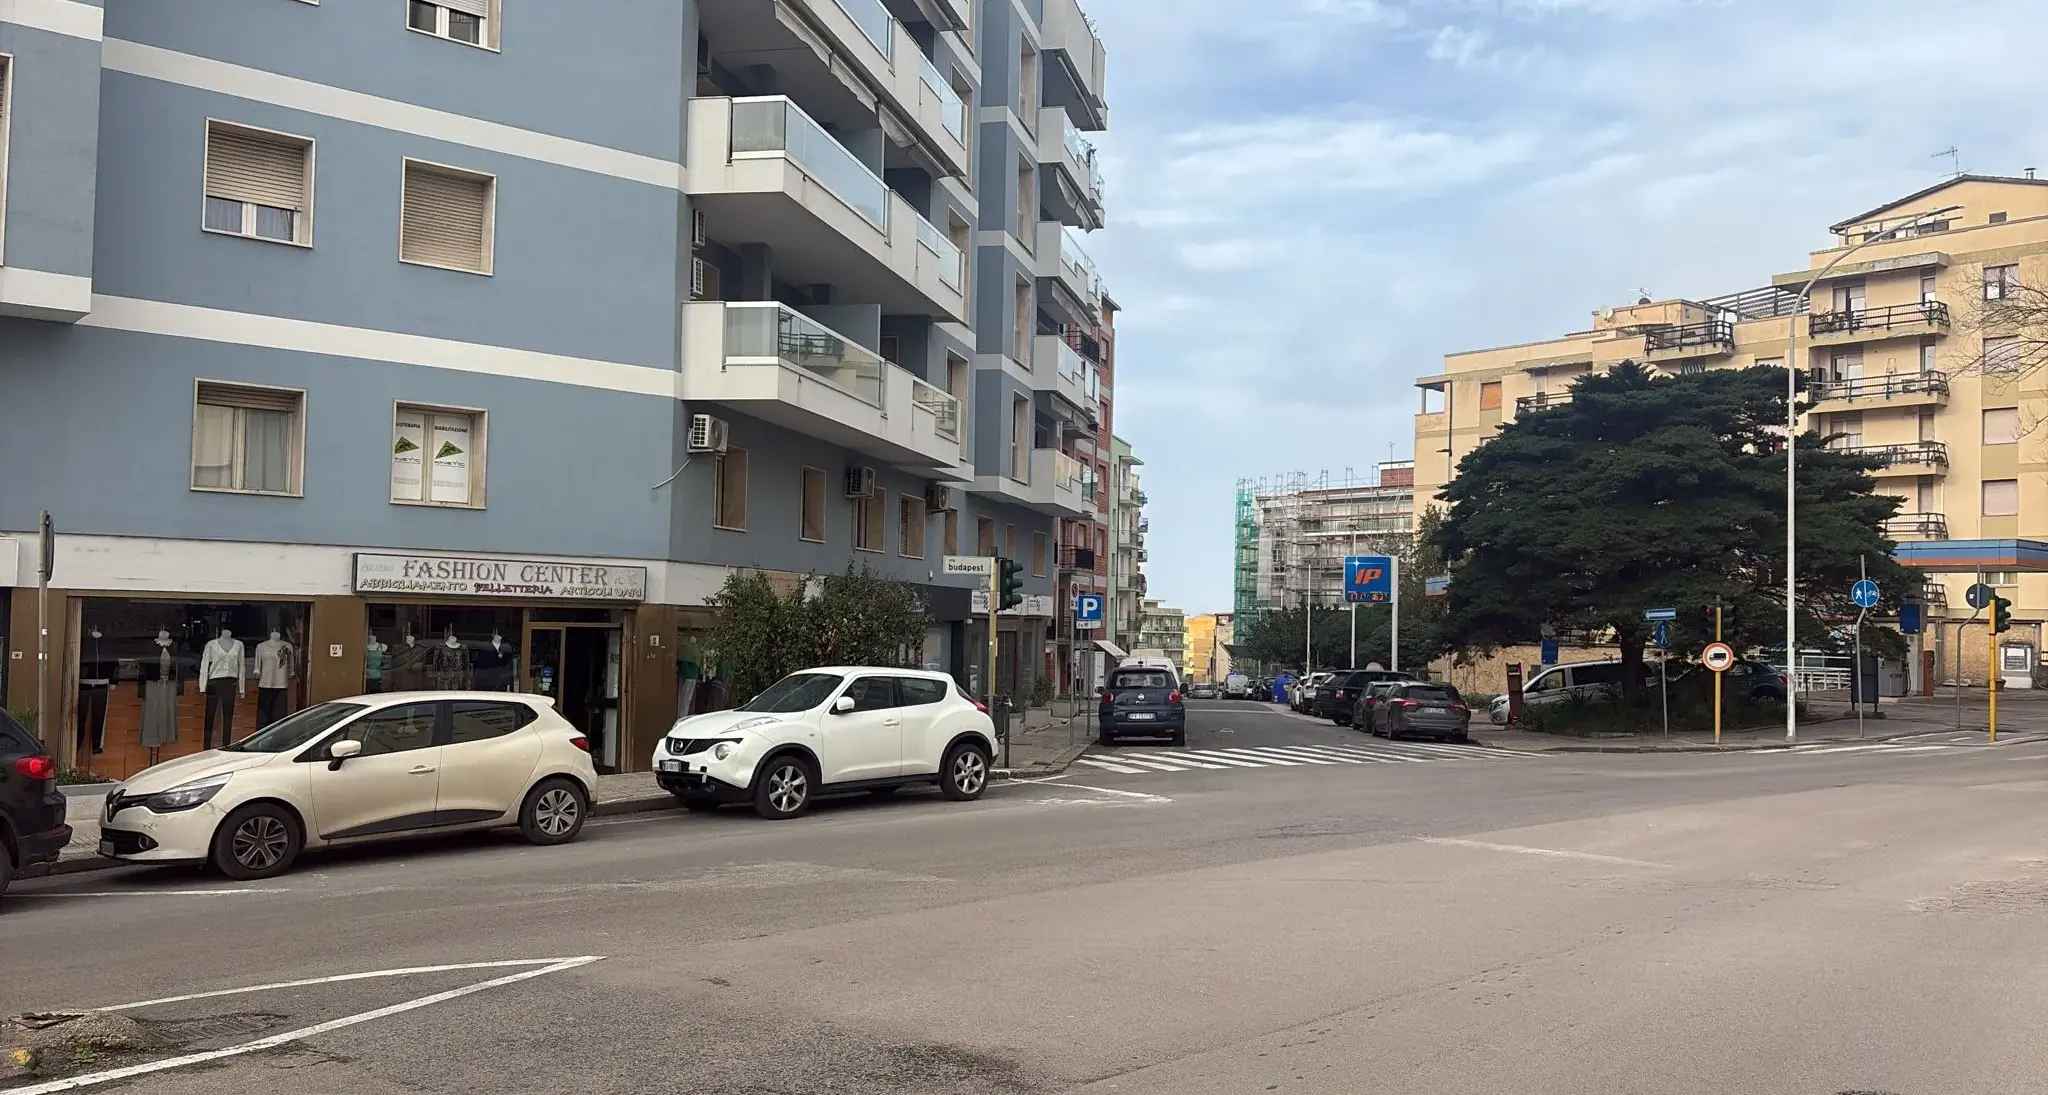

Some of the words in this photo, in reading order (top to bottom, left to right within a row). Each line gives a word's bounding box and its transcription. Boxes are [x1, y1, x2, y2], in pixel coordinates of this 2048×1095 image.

[434, 425, 469, 433] RIABILITAZIONE
[403, 559, 508, 581] FASHION
[520, 564, 608, 586] CENTER
[948, 563, 984, 572] budapest
[1355, 569, 1382, 584] IP
[359, 578, 468, 592] ABBIGLIAMENTO
[473, 582, 553, 595] PELLETTERIA
[560, 584, 612, 597] ARTICOLI
[1082, 597, 1098, 617] P
